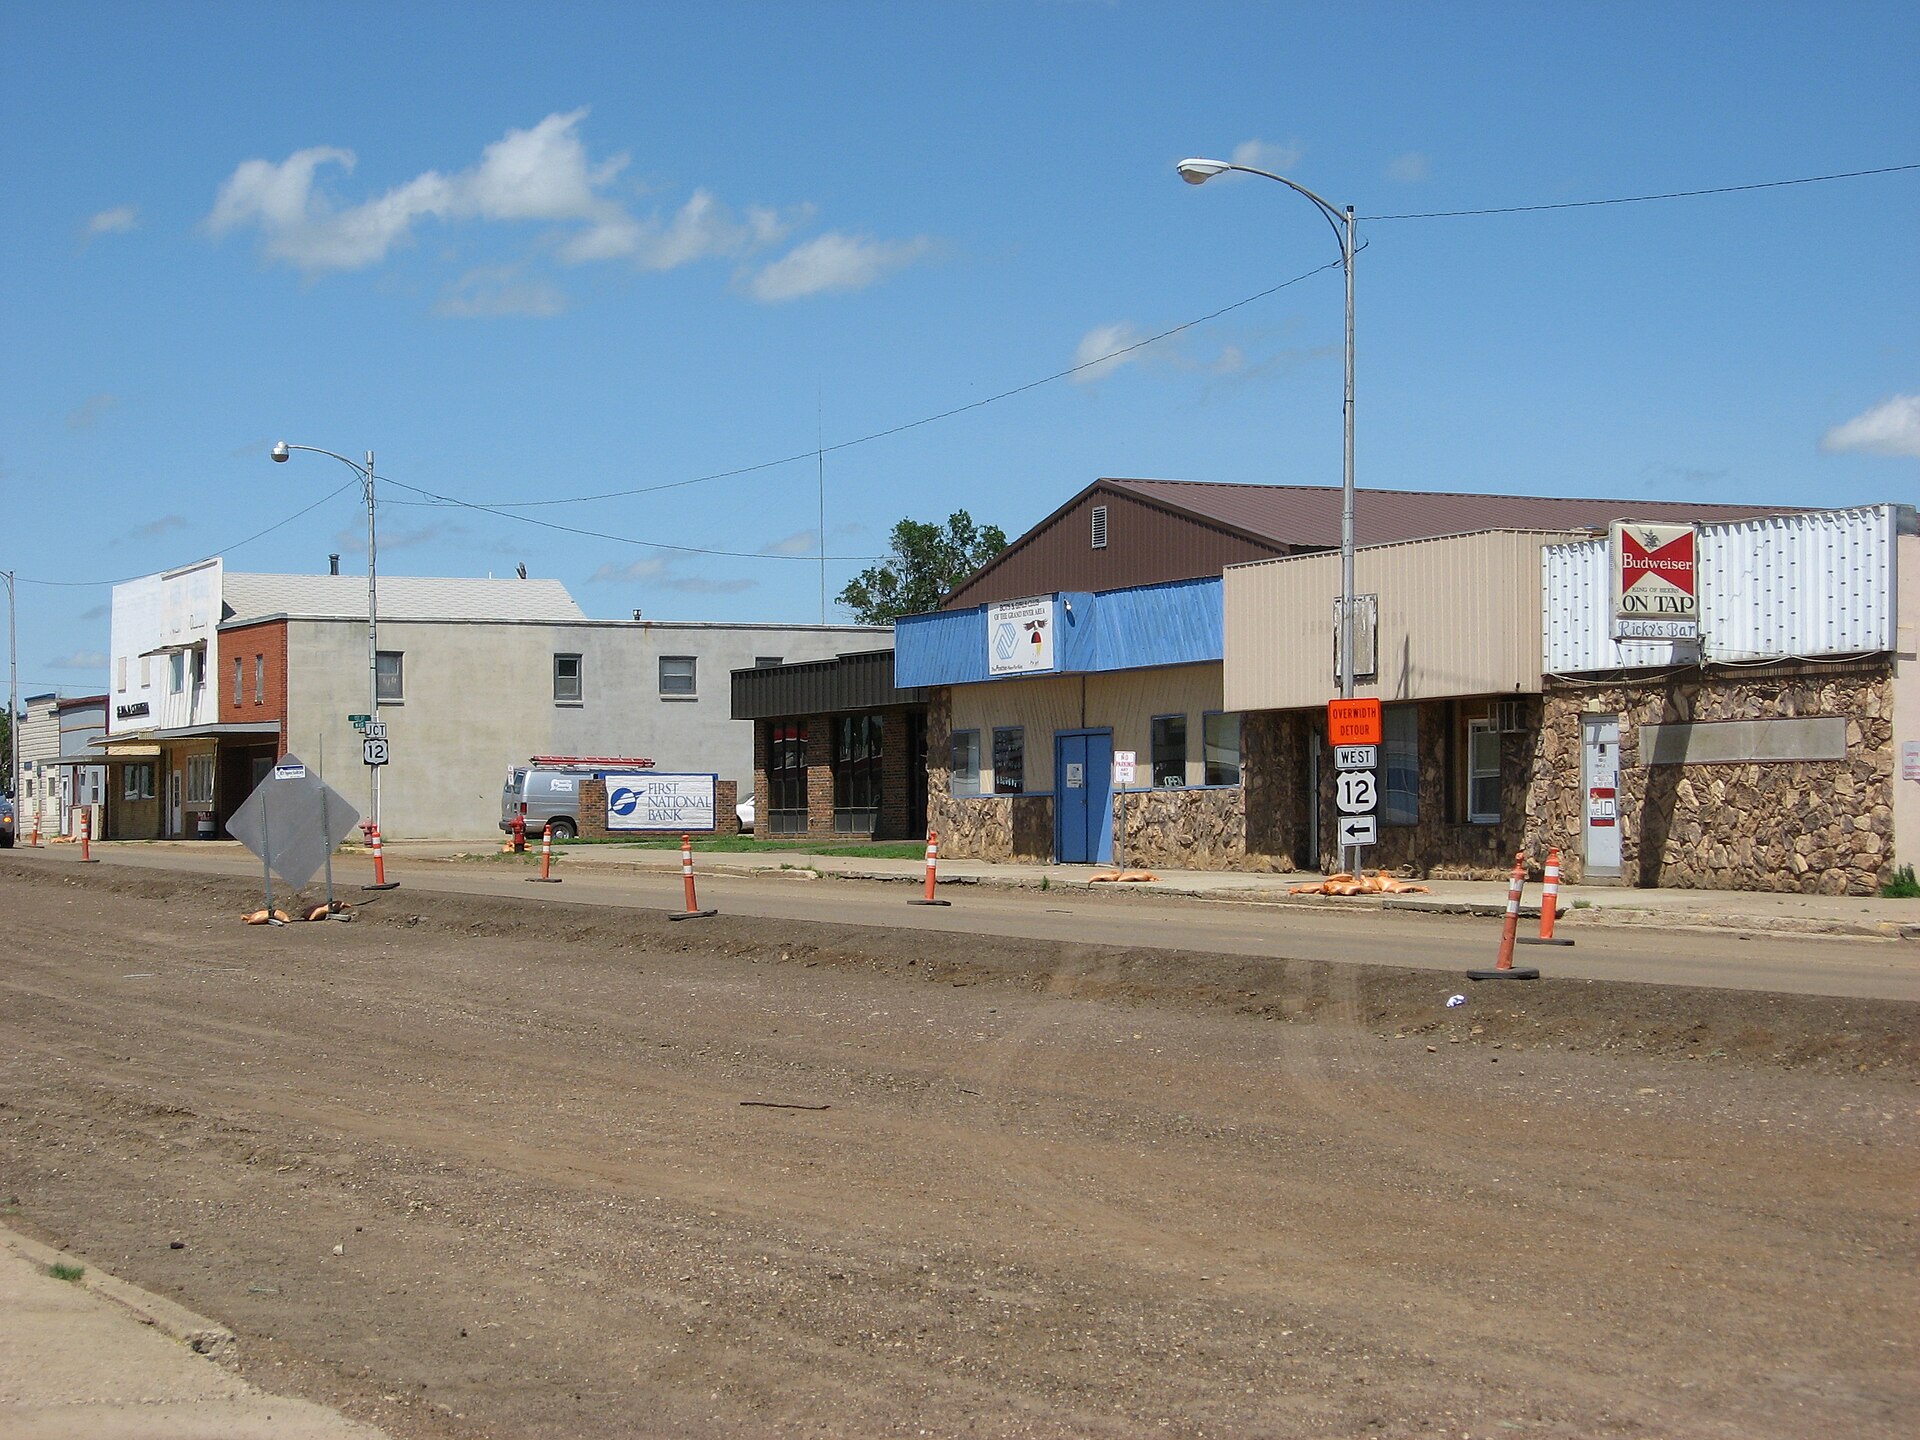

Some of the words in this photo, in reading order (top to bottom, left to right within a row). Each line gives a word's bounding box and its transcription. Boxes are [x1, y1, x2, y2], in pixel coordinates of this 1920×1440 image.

[1623, 553, 1693, 570] Budweiser
[1622, 594, 1648, 612] ON
[1654, 595, 1694, 613] TAP
[1008, 610, 1022, 619] GRAND
[1618, 621, 1663, 637] Ricky's
[1666, 622, 1695, 637] Bar
[1333, 708, 1376, 719] OVERWIDTH
[366, 725, 384, 736] JCT
[1340, 725, 1369, 736] DETOUR
[369, 745, 383, 758] 12
[1341, 750, 1370, 763] WEST
[1164, 776, 1184, 787] OPEN
[648, 783, 679, 794] FIRST
[1344, 780, 1369, 804] 12
[648, 796, 711, 808] NATIONAL
[648, 809, 682, 821] BANK
